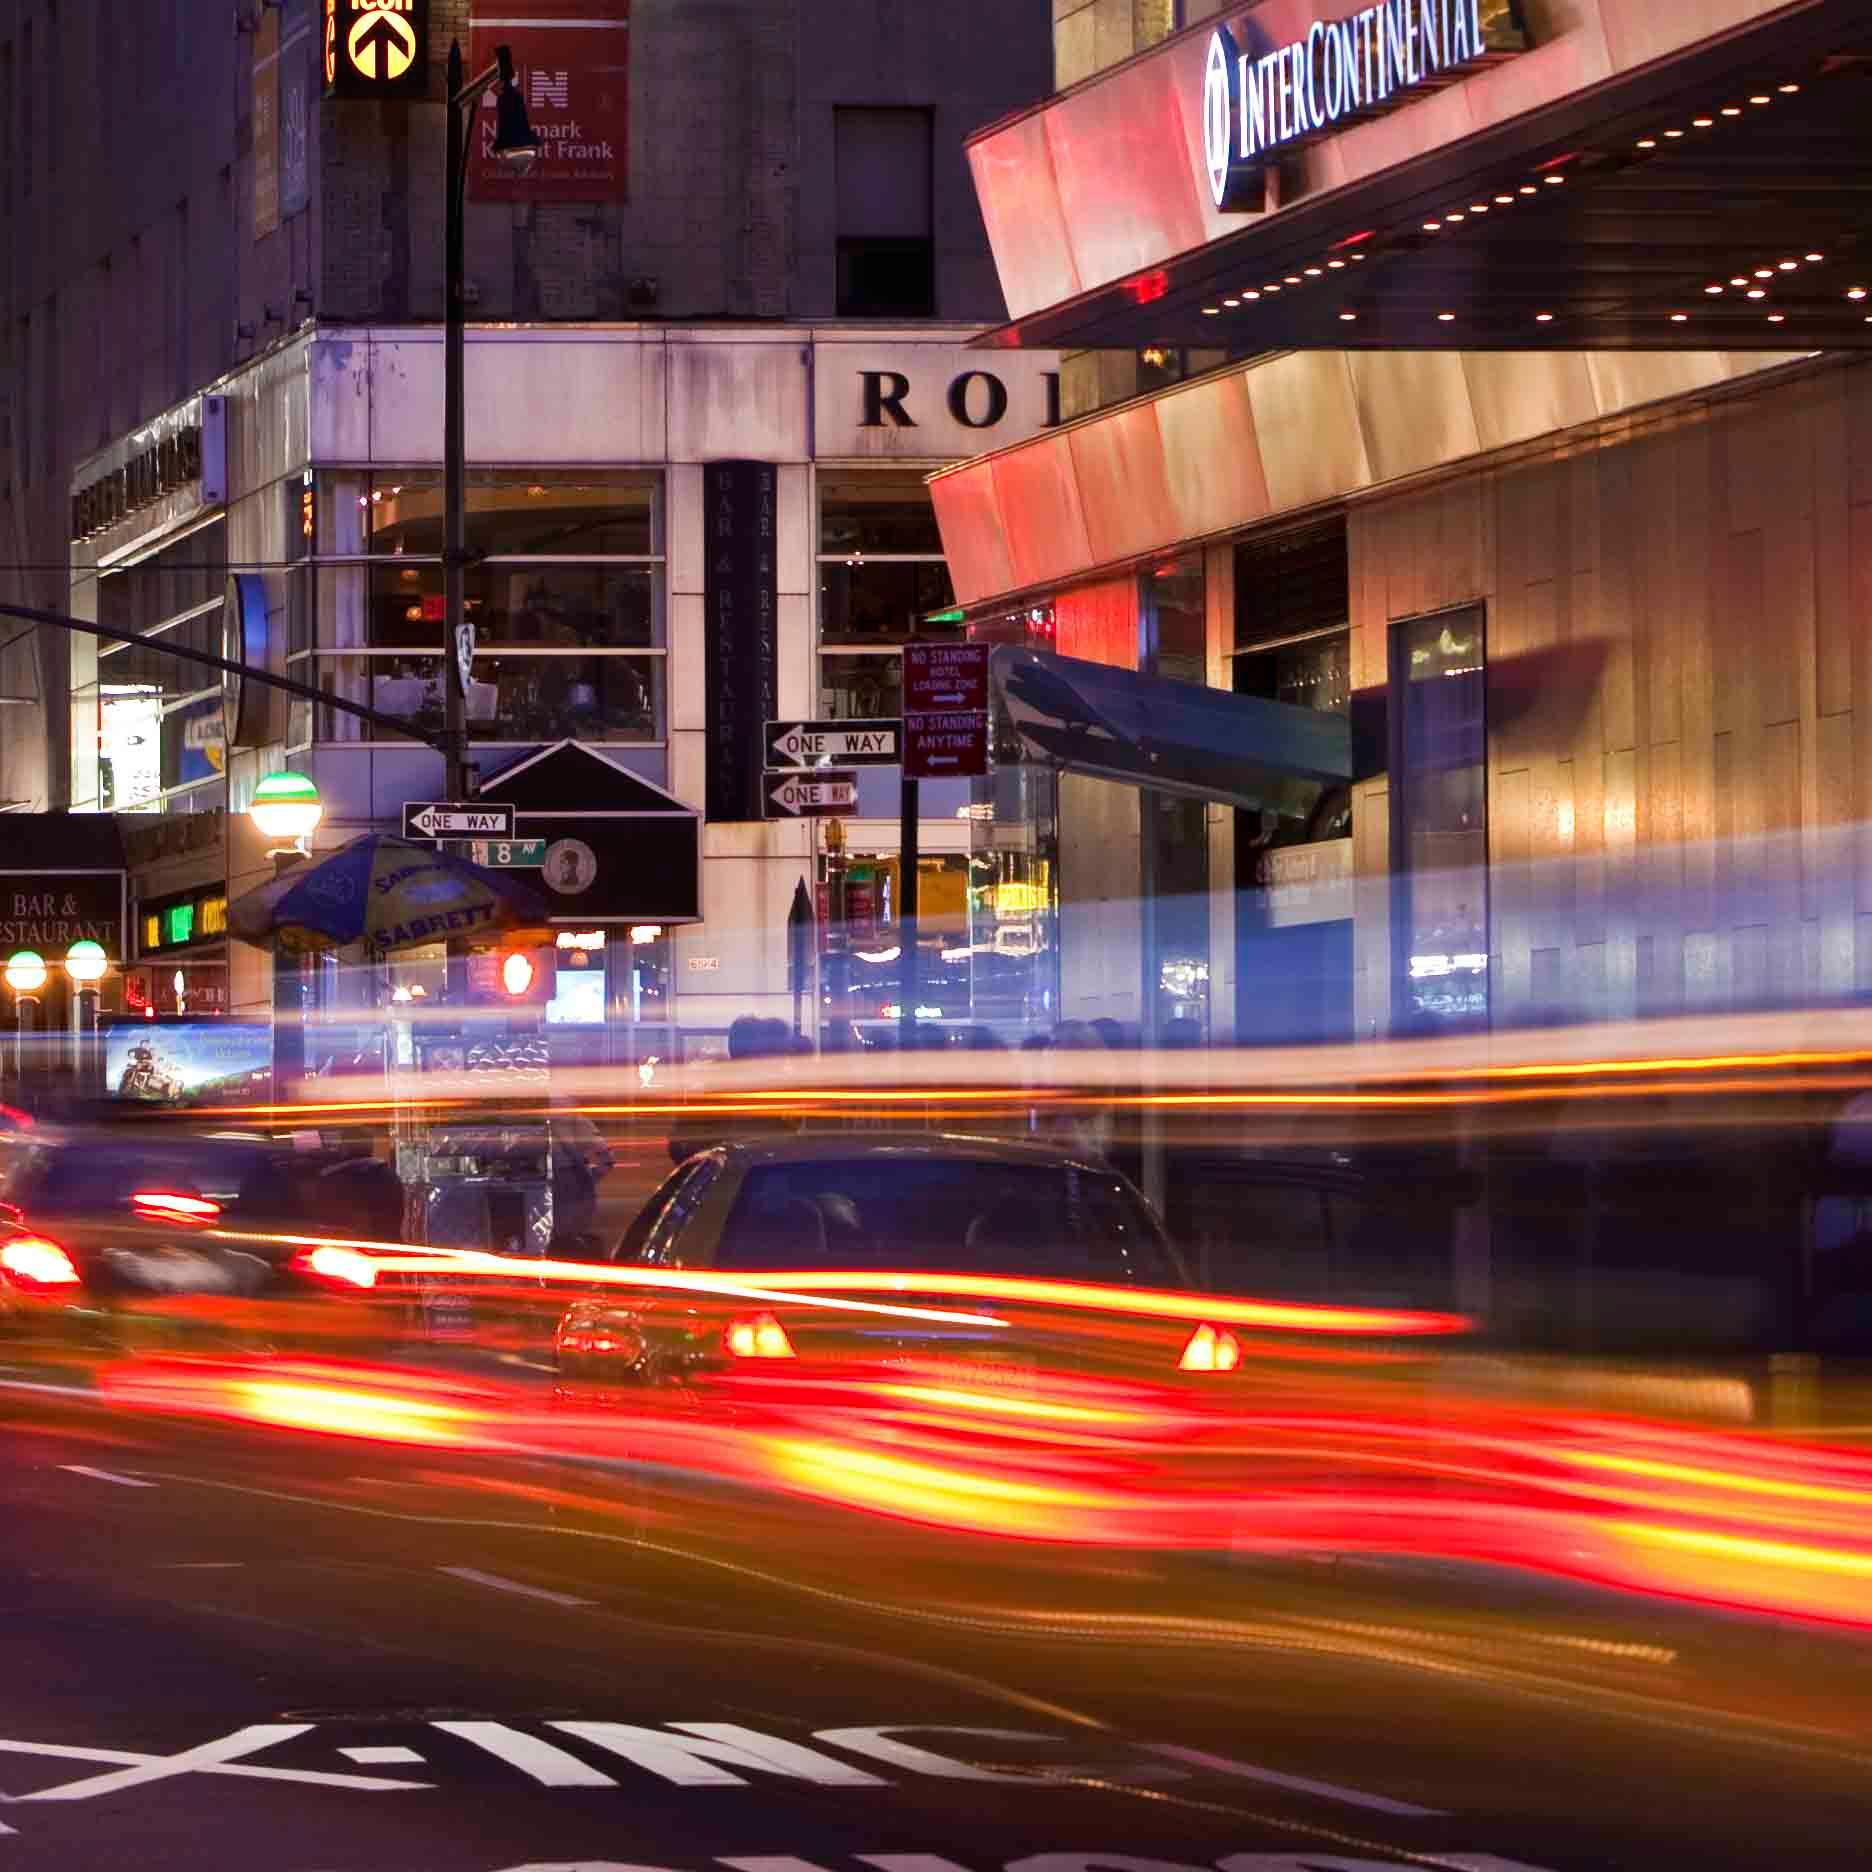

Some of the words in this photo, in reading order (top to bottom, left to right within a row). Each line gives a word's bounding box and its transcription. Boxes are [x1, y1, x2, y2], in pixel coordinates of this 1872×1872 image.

[482, 120, 581, 139] Nmark
[558, 140, 614, 159] Frank
[911, 650, 927, 664] NO
[931, 649, 981, 664] STANDING
[930, 666, 960, 677] HOTEL
[913, 679, 952, 691] LOADING
[956, 679, 977, 690] ZONE
[908, 717, 925, 729] NO
[928, 714, 983, 729] STANDING
[786, 735, 825, 754] ONE
[845, 734, 889, 752] WAY
[917, 734, 976, 748] ANYTIME
[783, 786, 821, 804] ONE
[832, 784, 850, 801] WAY
[421, 815, 452, 829] ONE
[466, 815, 499, 829] WAY
[497, 844, 512, 864] 8
[522, 845, 536, 855] AV
[14, 894, 54, 917] BAR
[61, 893, 78, 916] &
[378, 903, 495, 946] SABRETT
